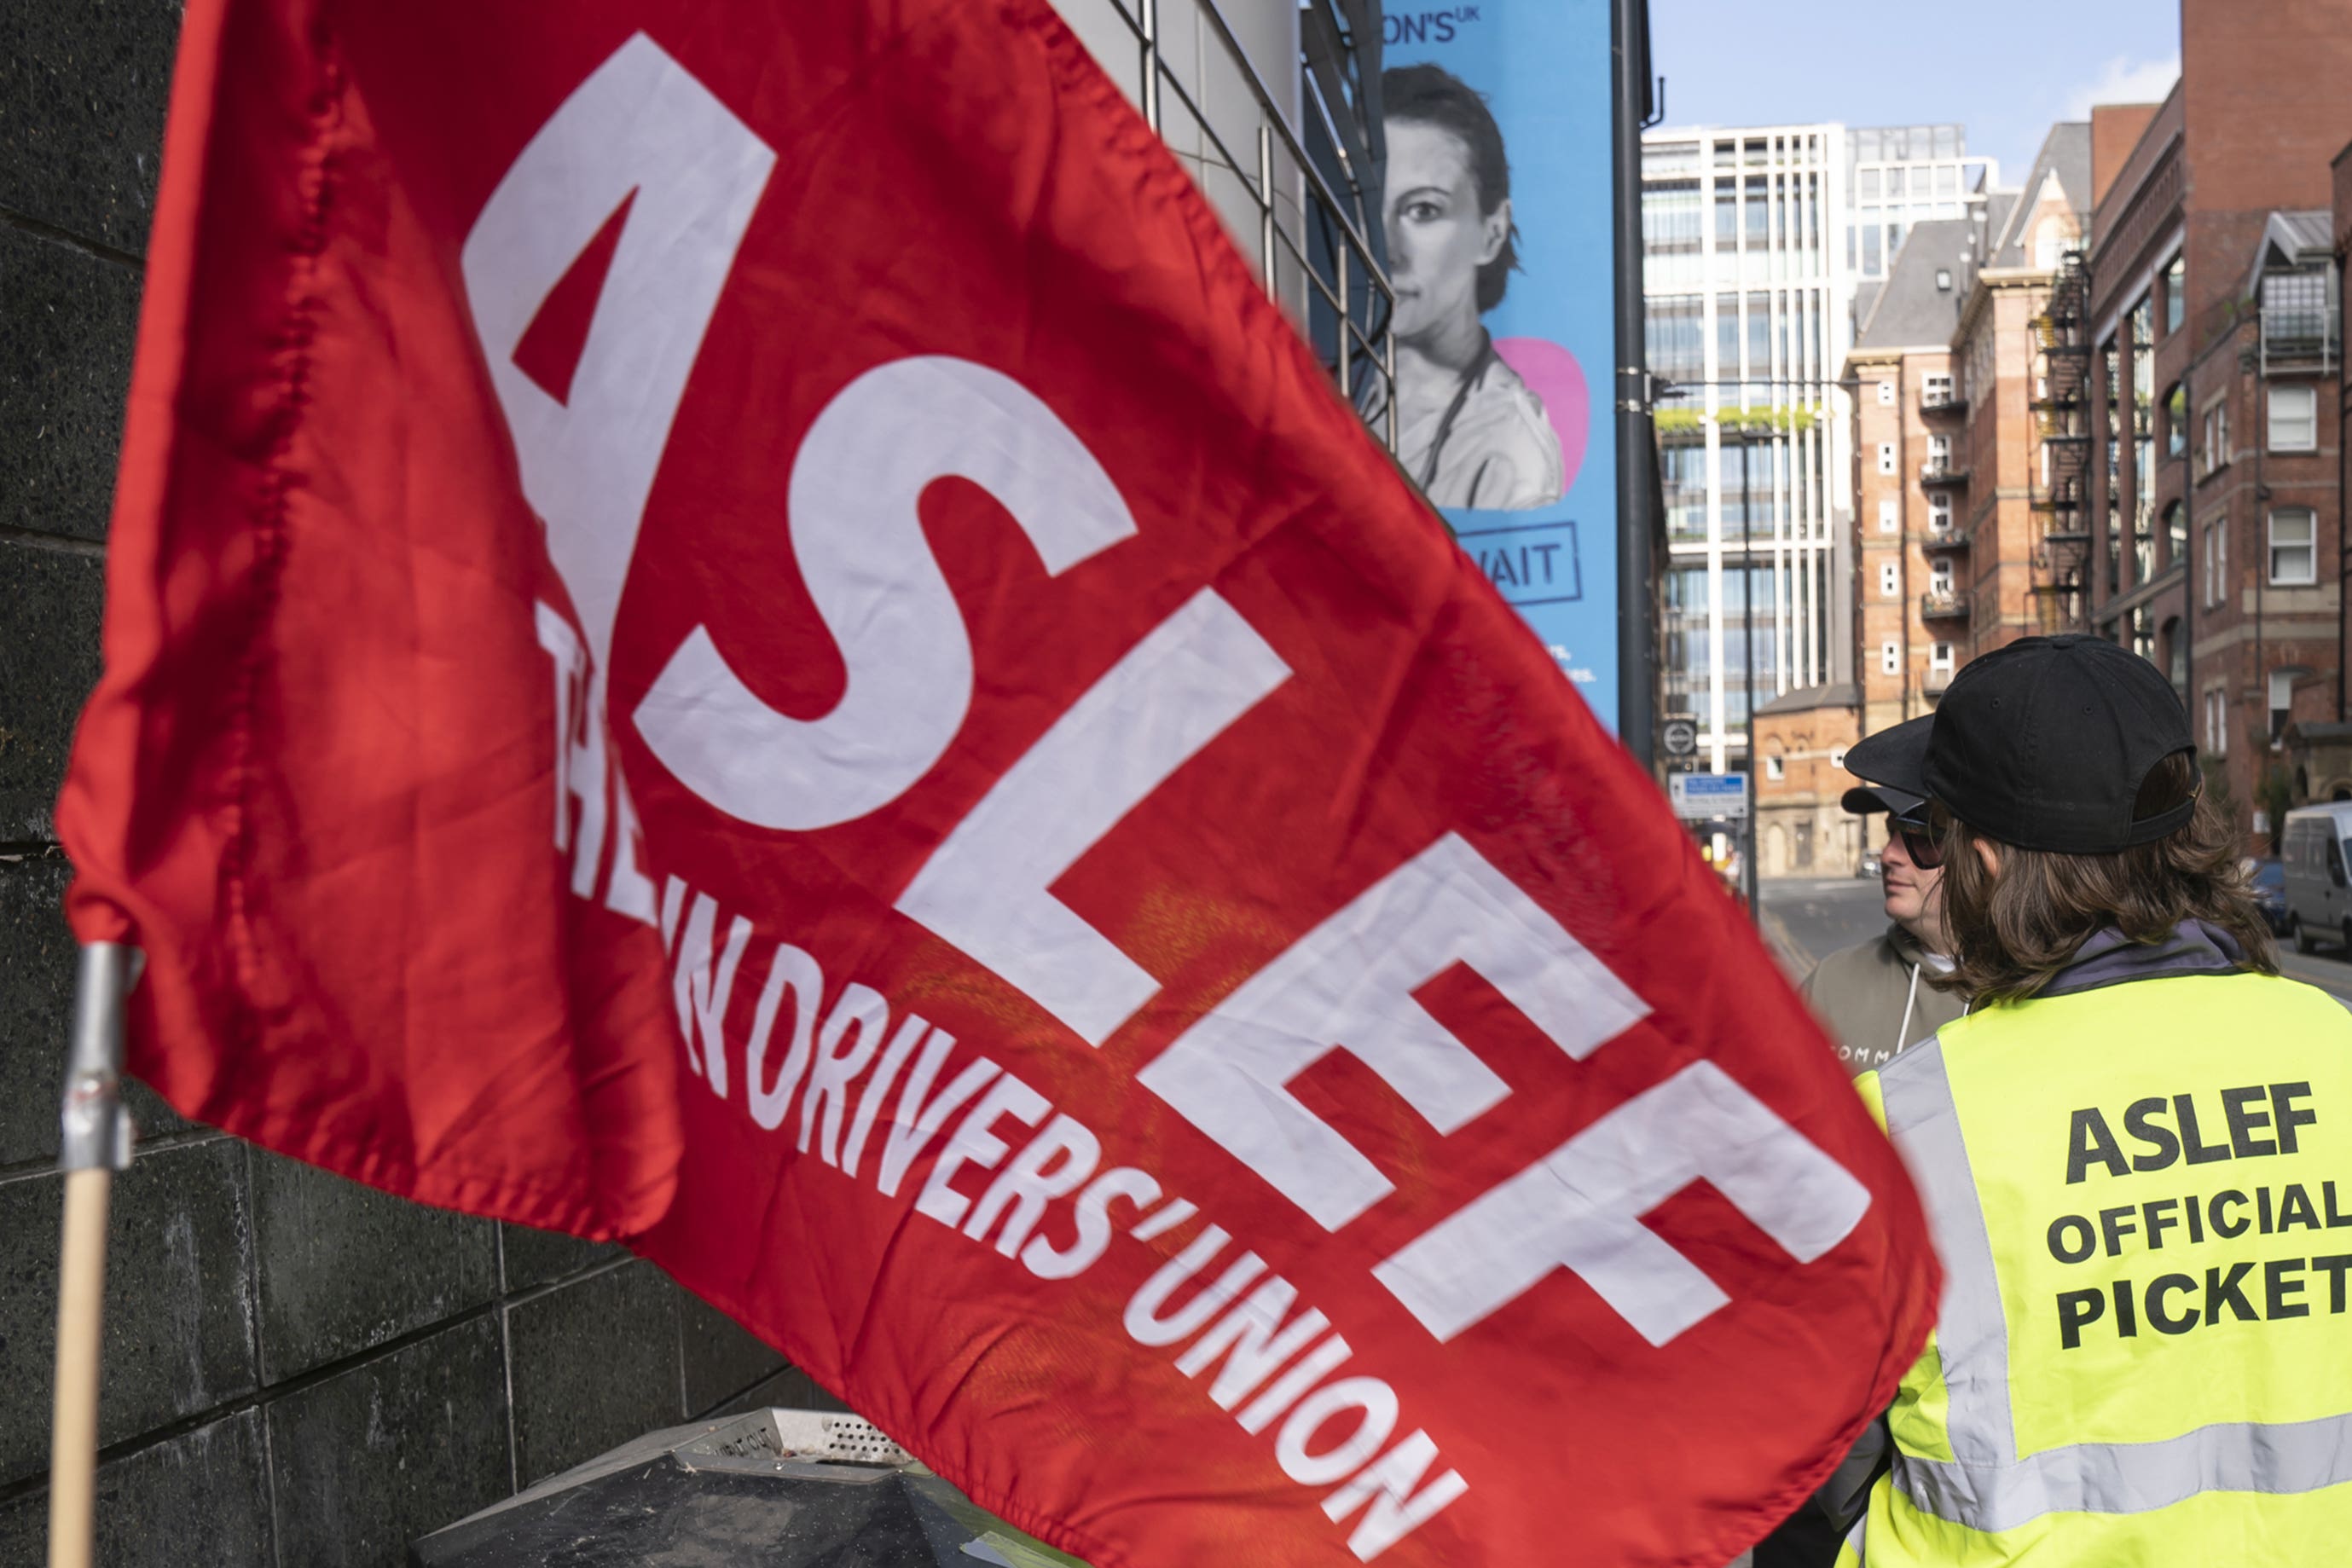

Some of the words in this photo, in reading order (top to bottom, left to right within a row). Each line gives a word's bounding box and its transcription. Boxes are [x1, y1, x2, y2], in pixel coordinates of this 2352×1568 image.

[461, 31, 1872, 1348] ASLEF
[2065, 1081, 2317, 1185] ASLEF
[746, 941, 1199, 1280] DRIVERS'
[1123, 1222, 1469, 1564] UNION
[2047, 1181, 2352, 1264] OFFICIAL
[2056, 1254, 2352, 1350] PICKET
